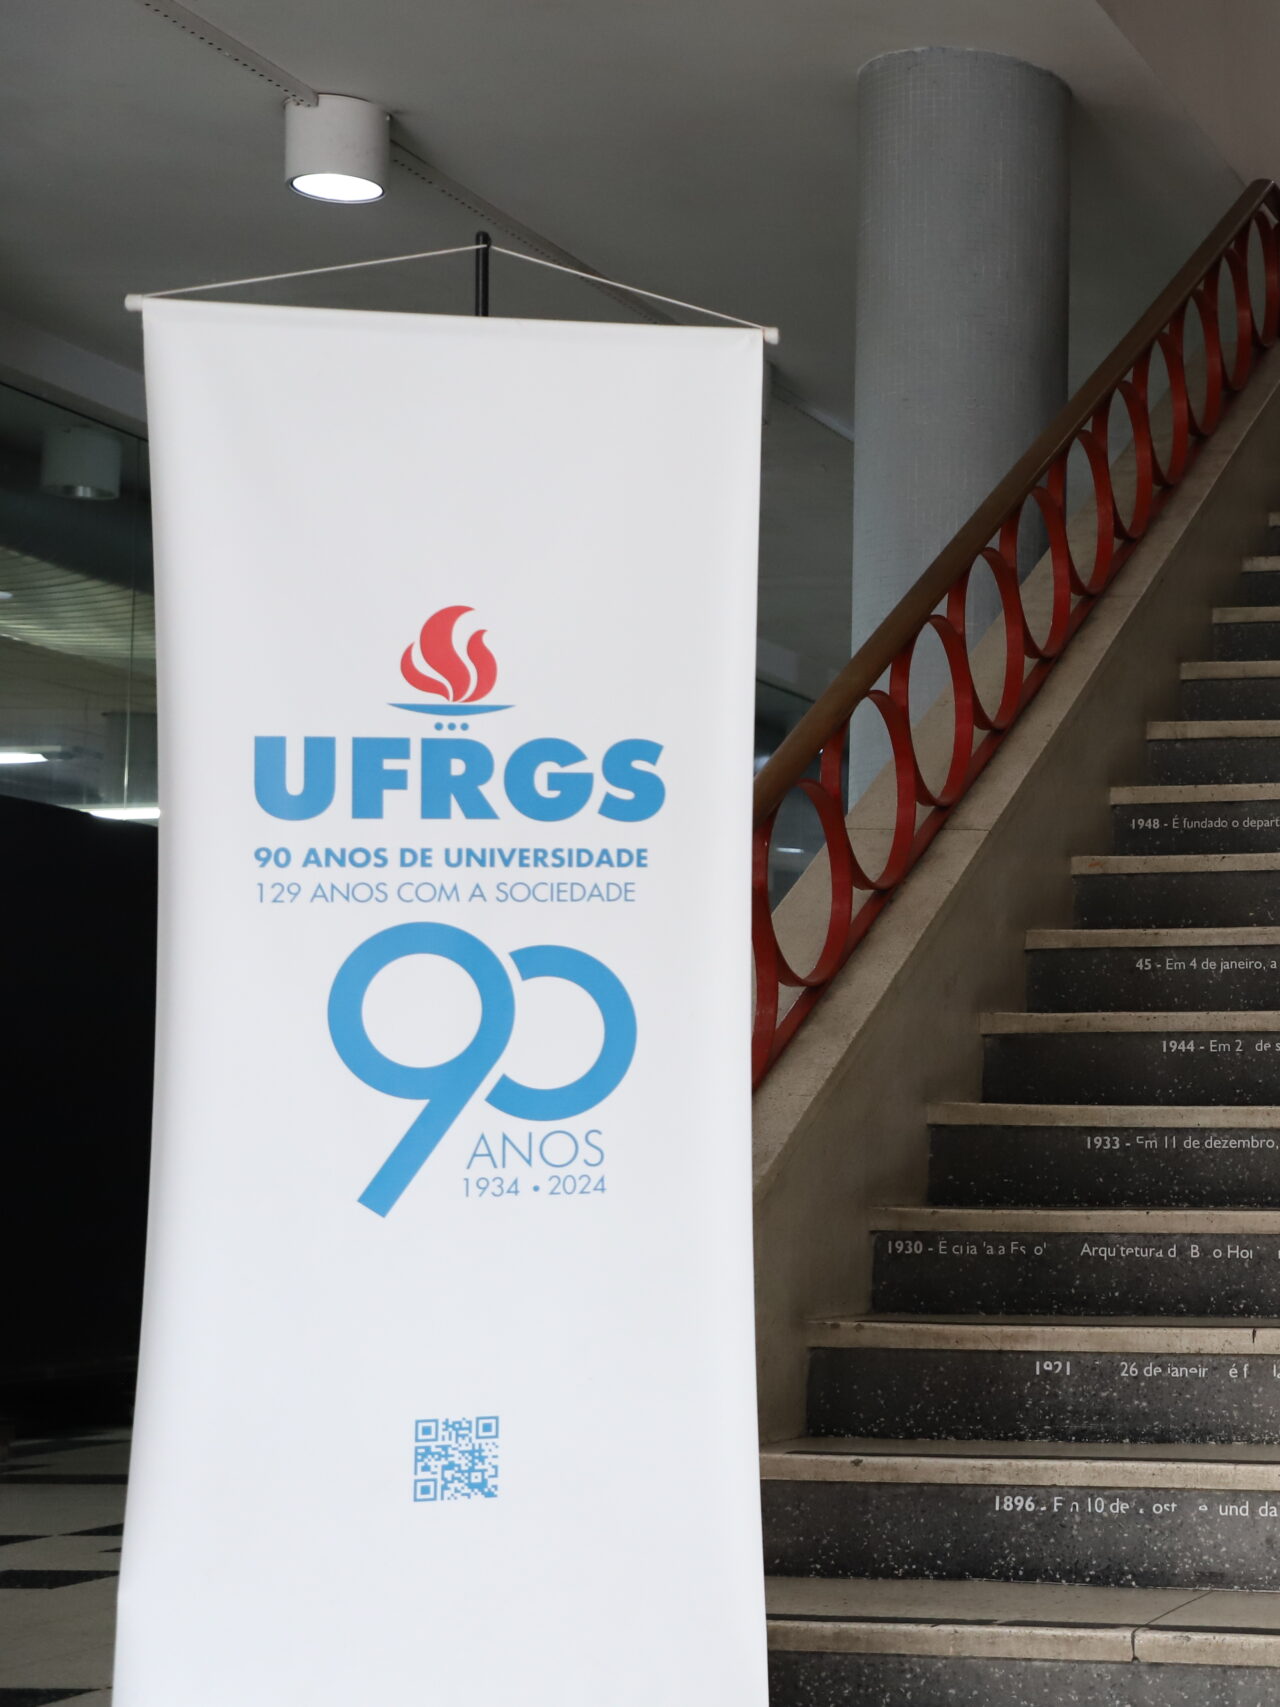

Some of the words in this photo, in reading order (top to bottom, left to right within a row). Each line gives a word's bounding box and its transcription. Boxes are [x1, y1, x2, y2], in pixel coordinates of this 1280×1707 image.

[251, 734, 668, 824] UFRGS
[1130, 818, 1160, 829] 1948
[1182, 816, 1229, 829] fundado
[251, 845, 294, 870] 90
[300, 845, 391, 869] ANOS
[398, 847, 434, 869] DE
[442, 847, 651, 869] UNIVERSIDADE
[256, 881, 303, 904] 129
[308, 881, 390, 904] ANOS
[395, 881, 462, 904] COM
[468, 882, 488, 901] A
[495, 881, 637, 903] SOCIEDADE
[1165, 957, 1186, 970] Em
[1200, 957, 1217, 970] de
[1219, 958, 1266, 973] janeiro,
[1162, 1039, 1195, 1052] 1944
[1208, 1039, 1231, 1052] Em
[325, 920, 639, 1220] 90
[465, 1127, 606, 1169] ANOS
[1086, 1136, 1120, 1149] 1933
[1164, 1135, 1176, 1149] 11
[1182, 1135, 1201, 1149] de
[1204, 1135, 1279, 1150] dezembro,
[463, 1175, 522, 1198] 1934
[547, 1173, 608, 1196] 2024
[887, 1240, 923, 1254] 1930
[1119, 1361, 1139, 1377] 26
[1142, 1362, 1163, 1377] de
[1087, 1497, 1105, 1513] 10
[1108, 1497, 1130, 1514] de
